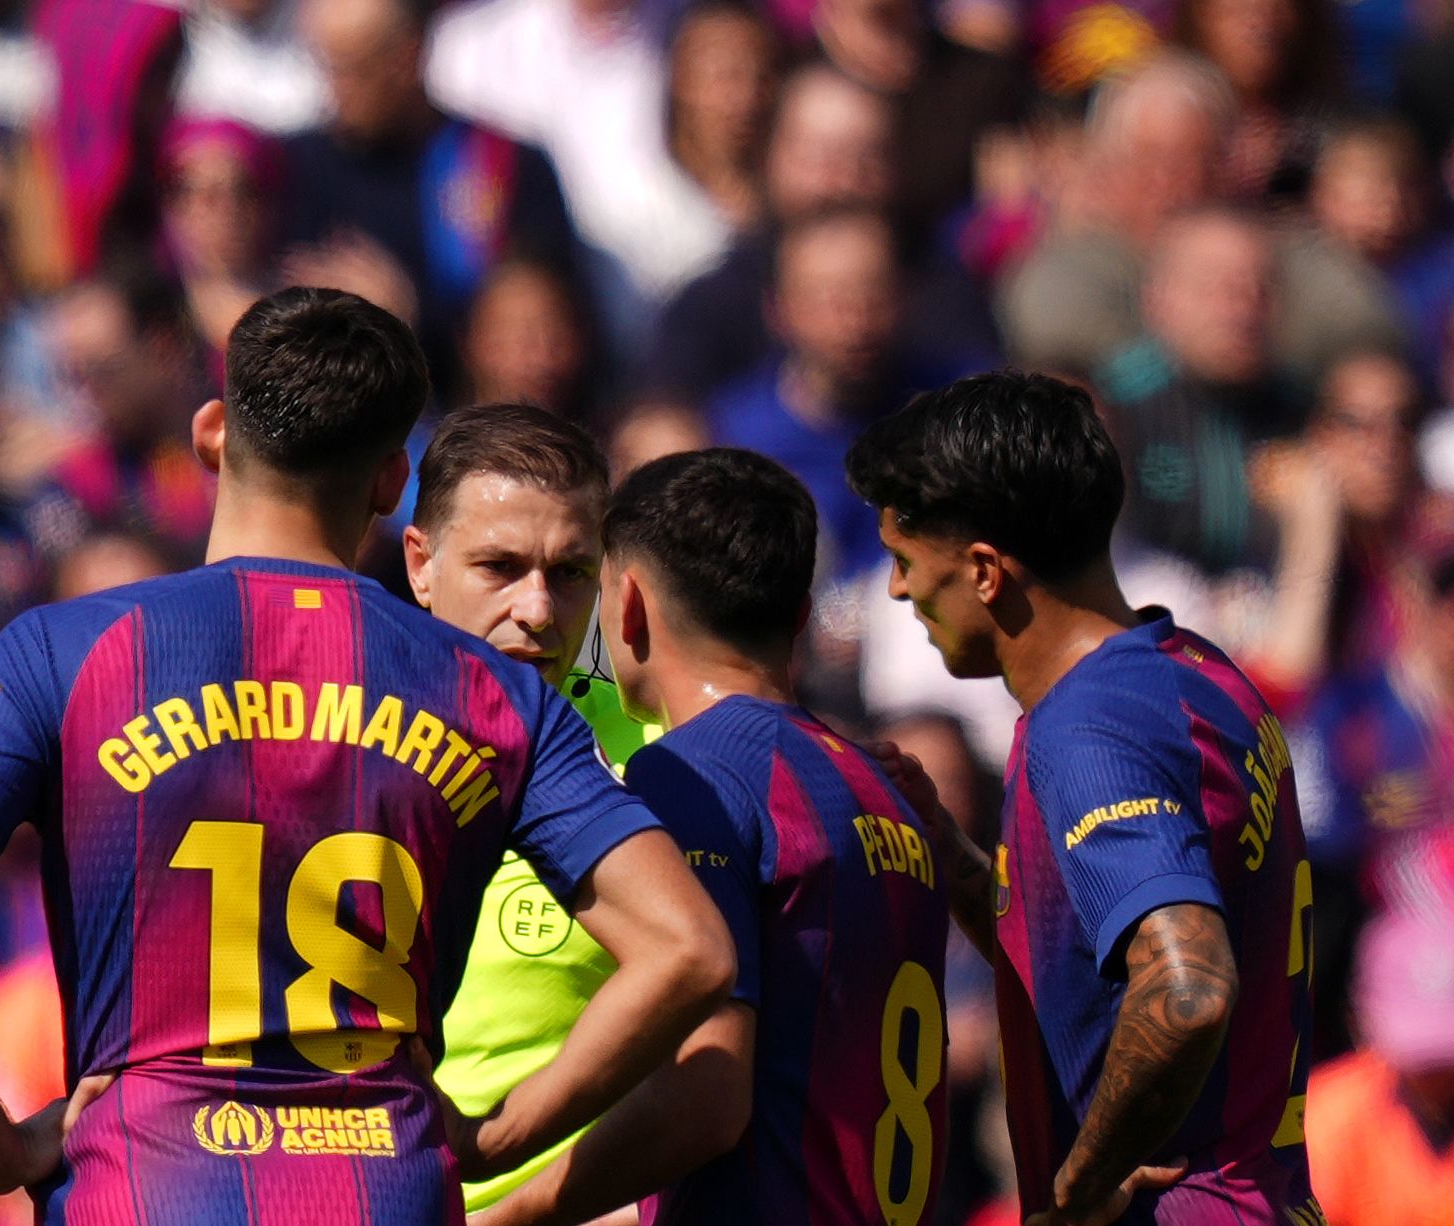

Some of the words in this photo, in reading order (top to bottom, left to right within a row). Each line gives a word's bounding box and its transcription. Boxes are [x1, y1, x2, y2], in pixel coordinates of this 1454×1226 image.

[97, 680, 305, 794] GERARD
[309, 681, 501, 829] MARTÍN
[1065, 797, 1159, 850] AMBILIGHT
[1163, 798, 1181, 815] tv
[708, 852, 729, 867] tv
[853, 814, 934, 891] PEDRI
[168, 820, 423, 1074] 18
[276, 1106, 391, 1128] UNHCR
[281, 1128, 394, 1149] ACNUR
